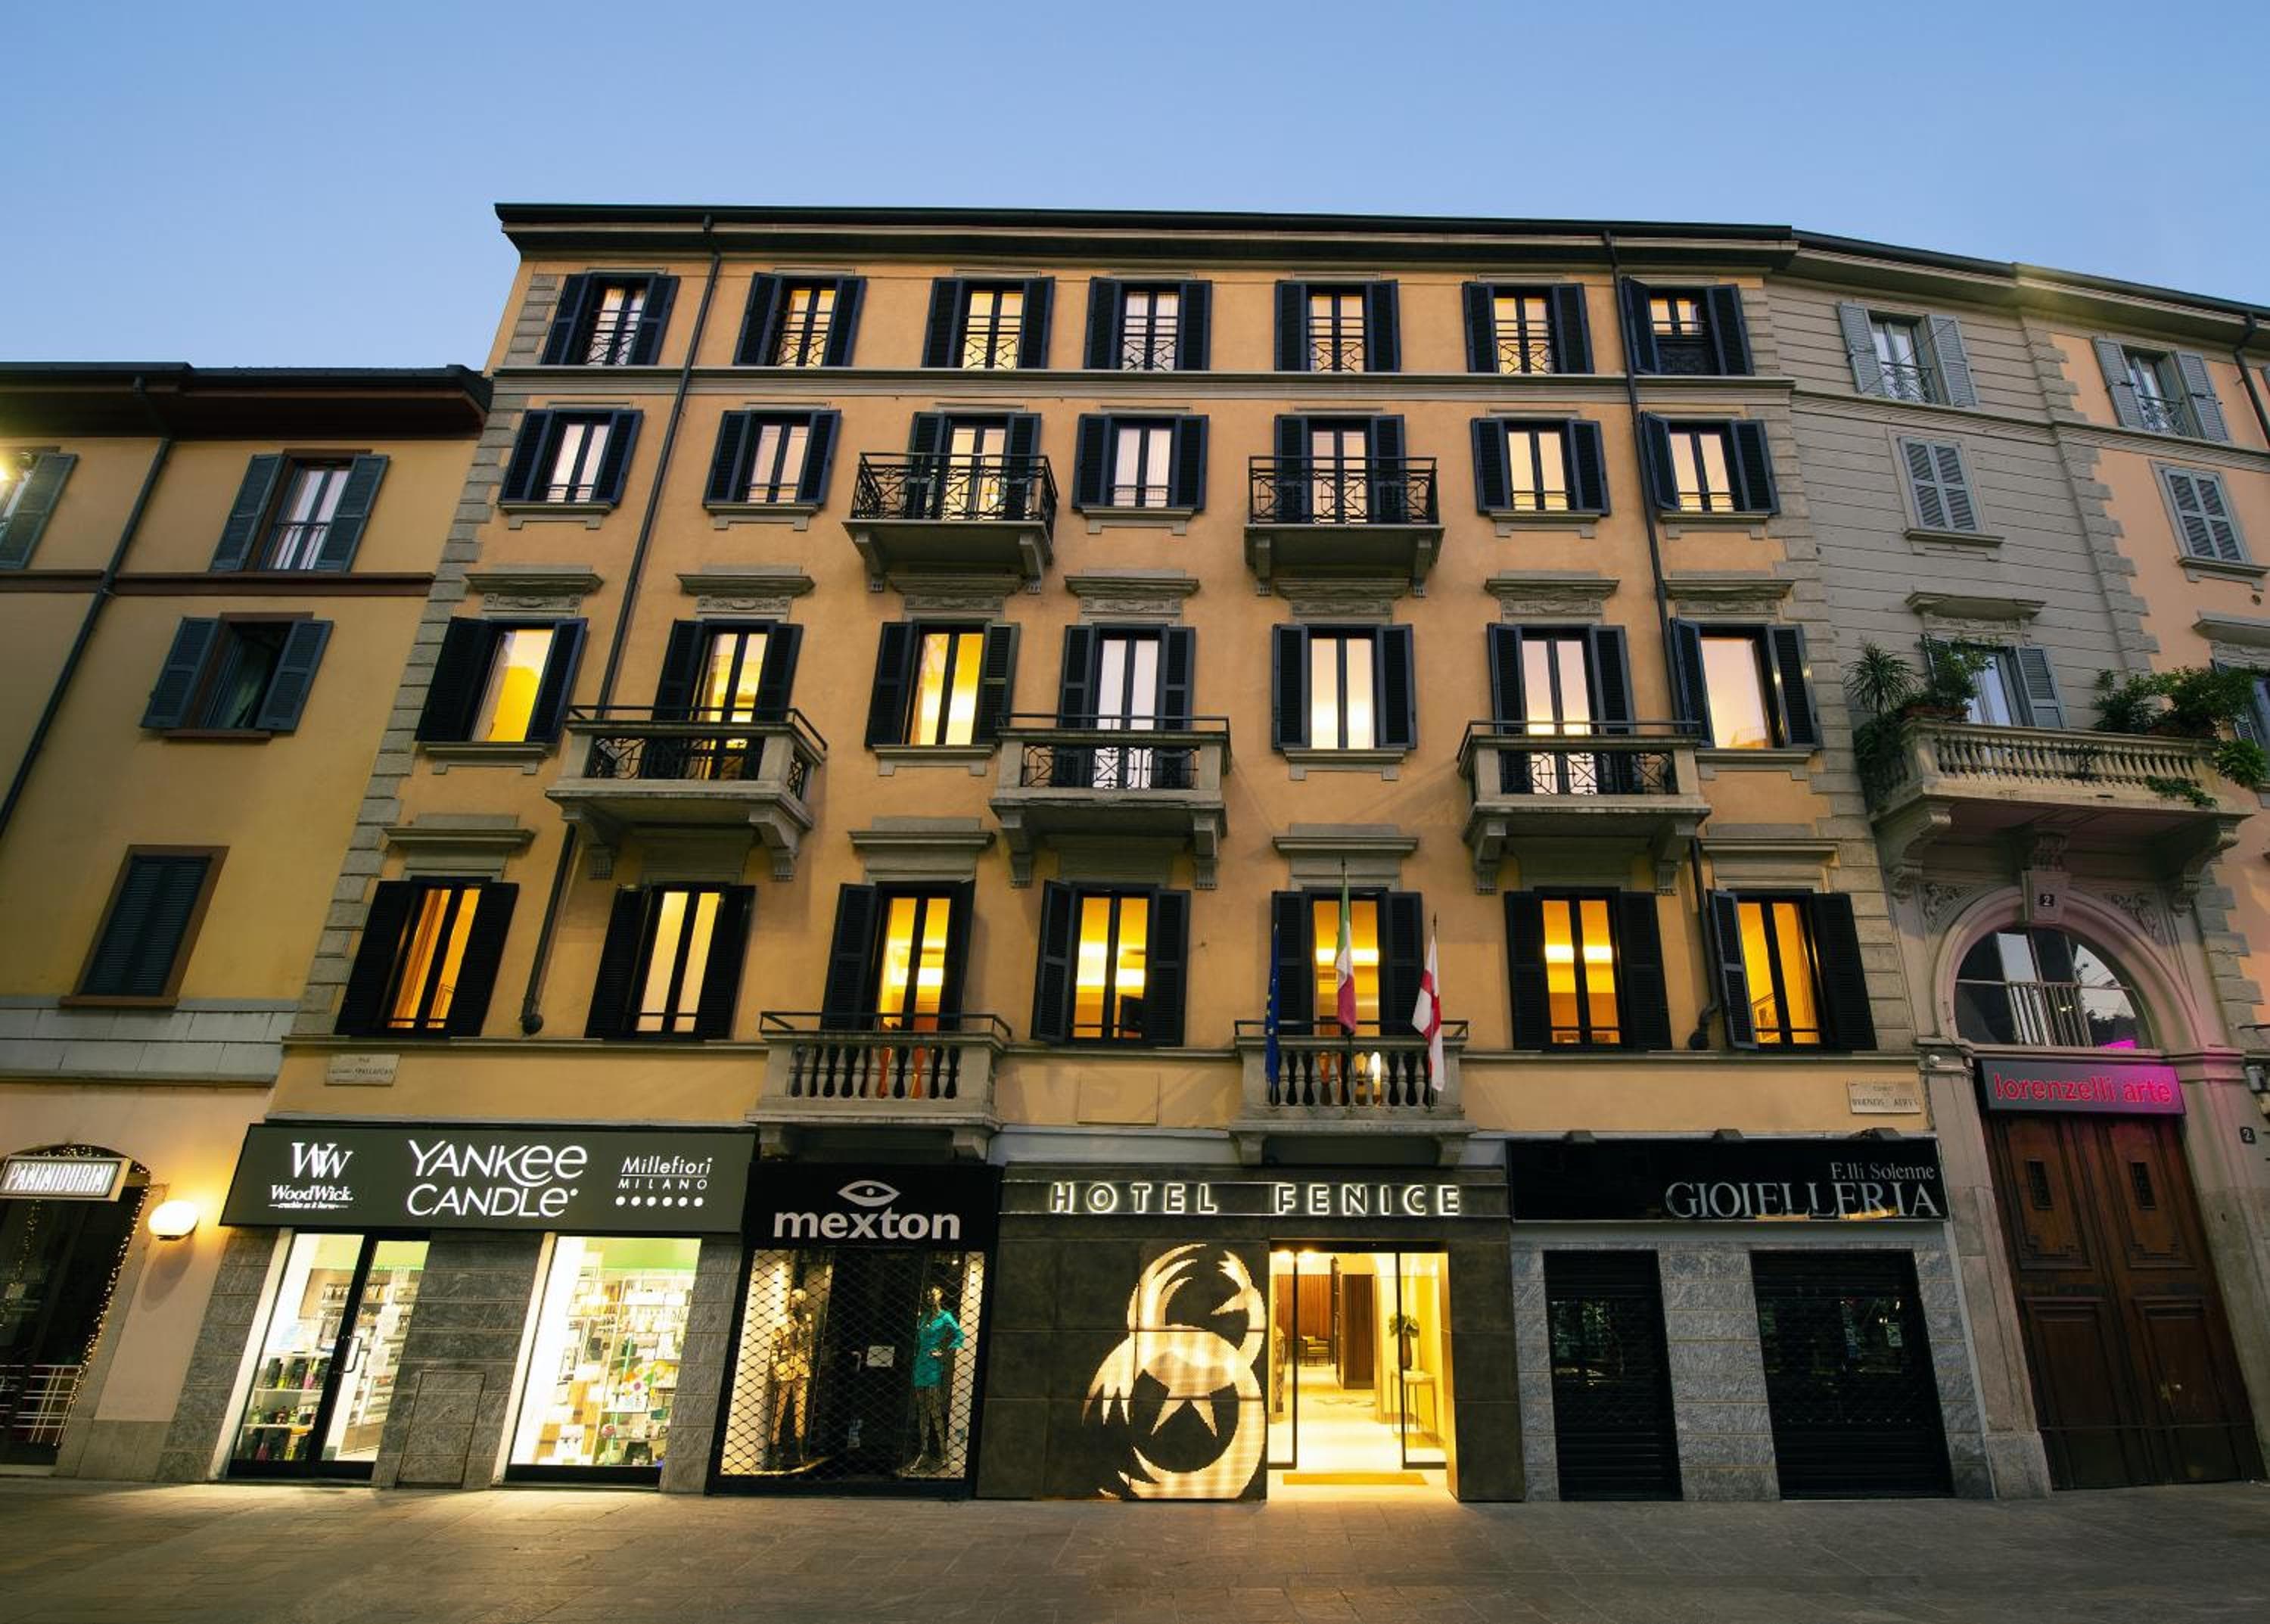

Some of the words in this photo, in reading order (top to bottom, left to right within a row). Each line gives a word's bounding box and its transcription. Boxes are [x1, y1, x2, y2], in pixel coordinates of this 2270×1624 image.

[1994, 1073, 2116, 1103] lorenzelli
[2123, 1081, 2172, 1103] arte
[621, 1156, 713, 1174] Millefiori
[617, 1178, 707, 1190] MILANO
[1049, 1181, 1217, 1214] HOTEL
[1275, 1183, 1460, 1216] FENICE
[1665, 1181, 1941, 1218] GIOIELLERIA
[773, 1206, 960, 1240] mexton
